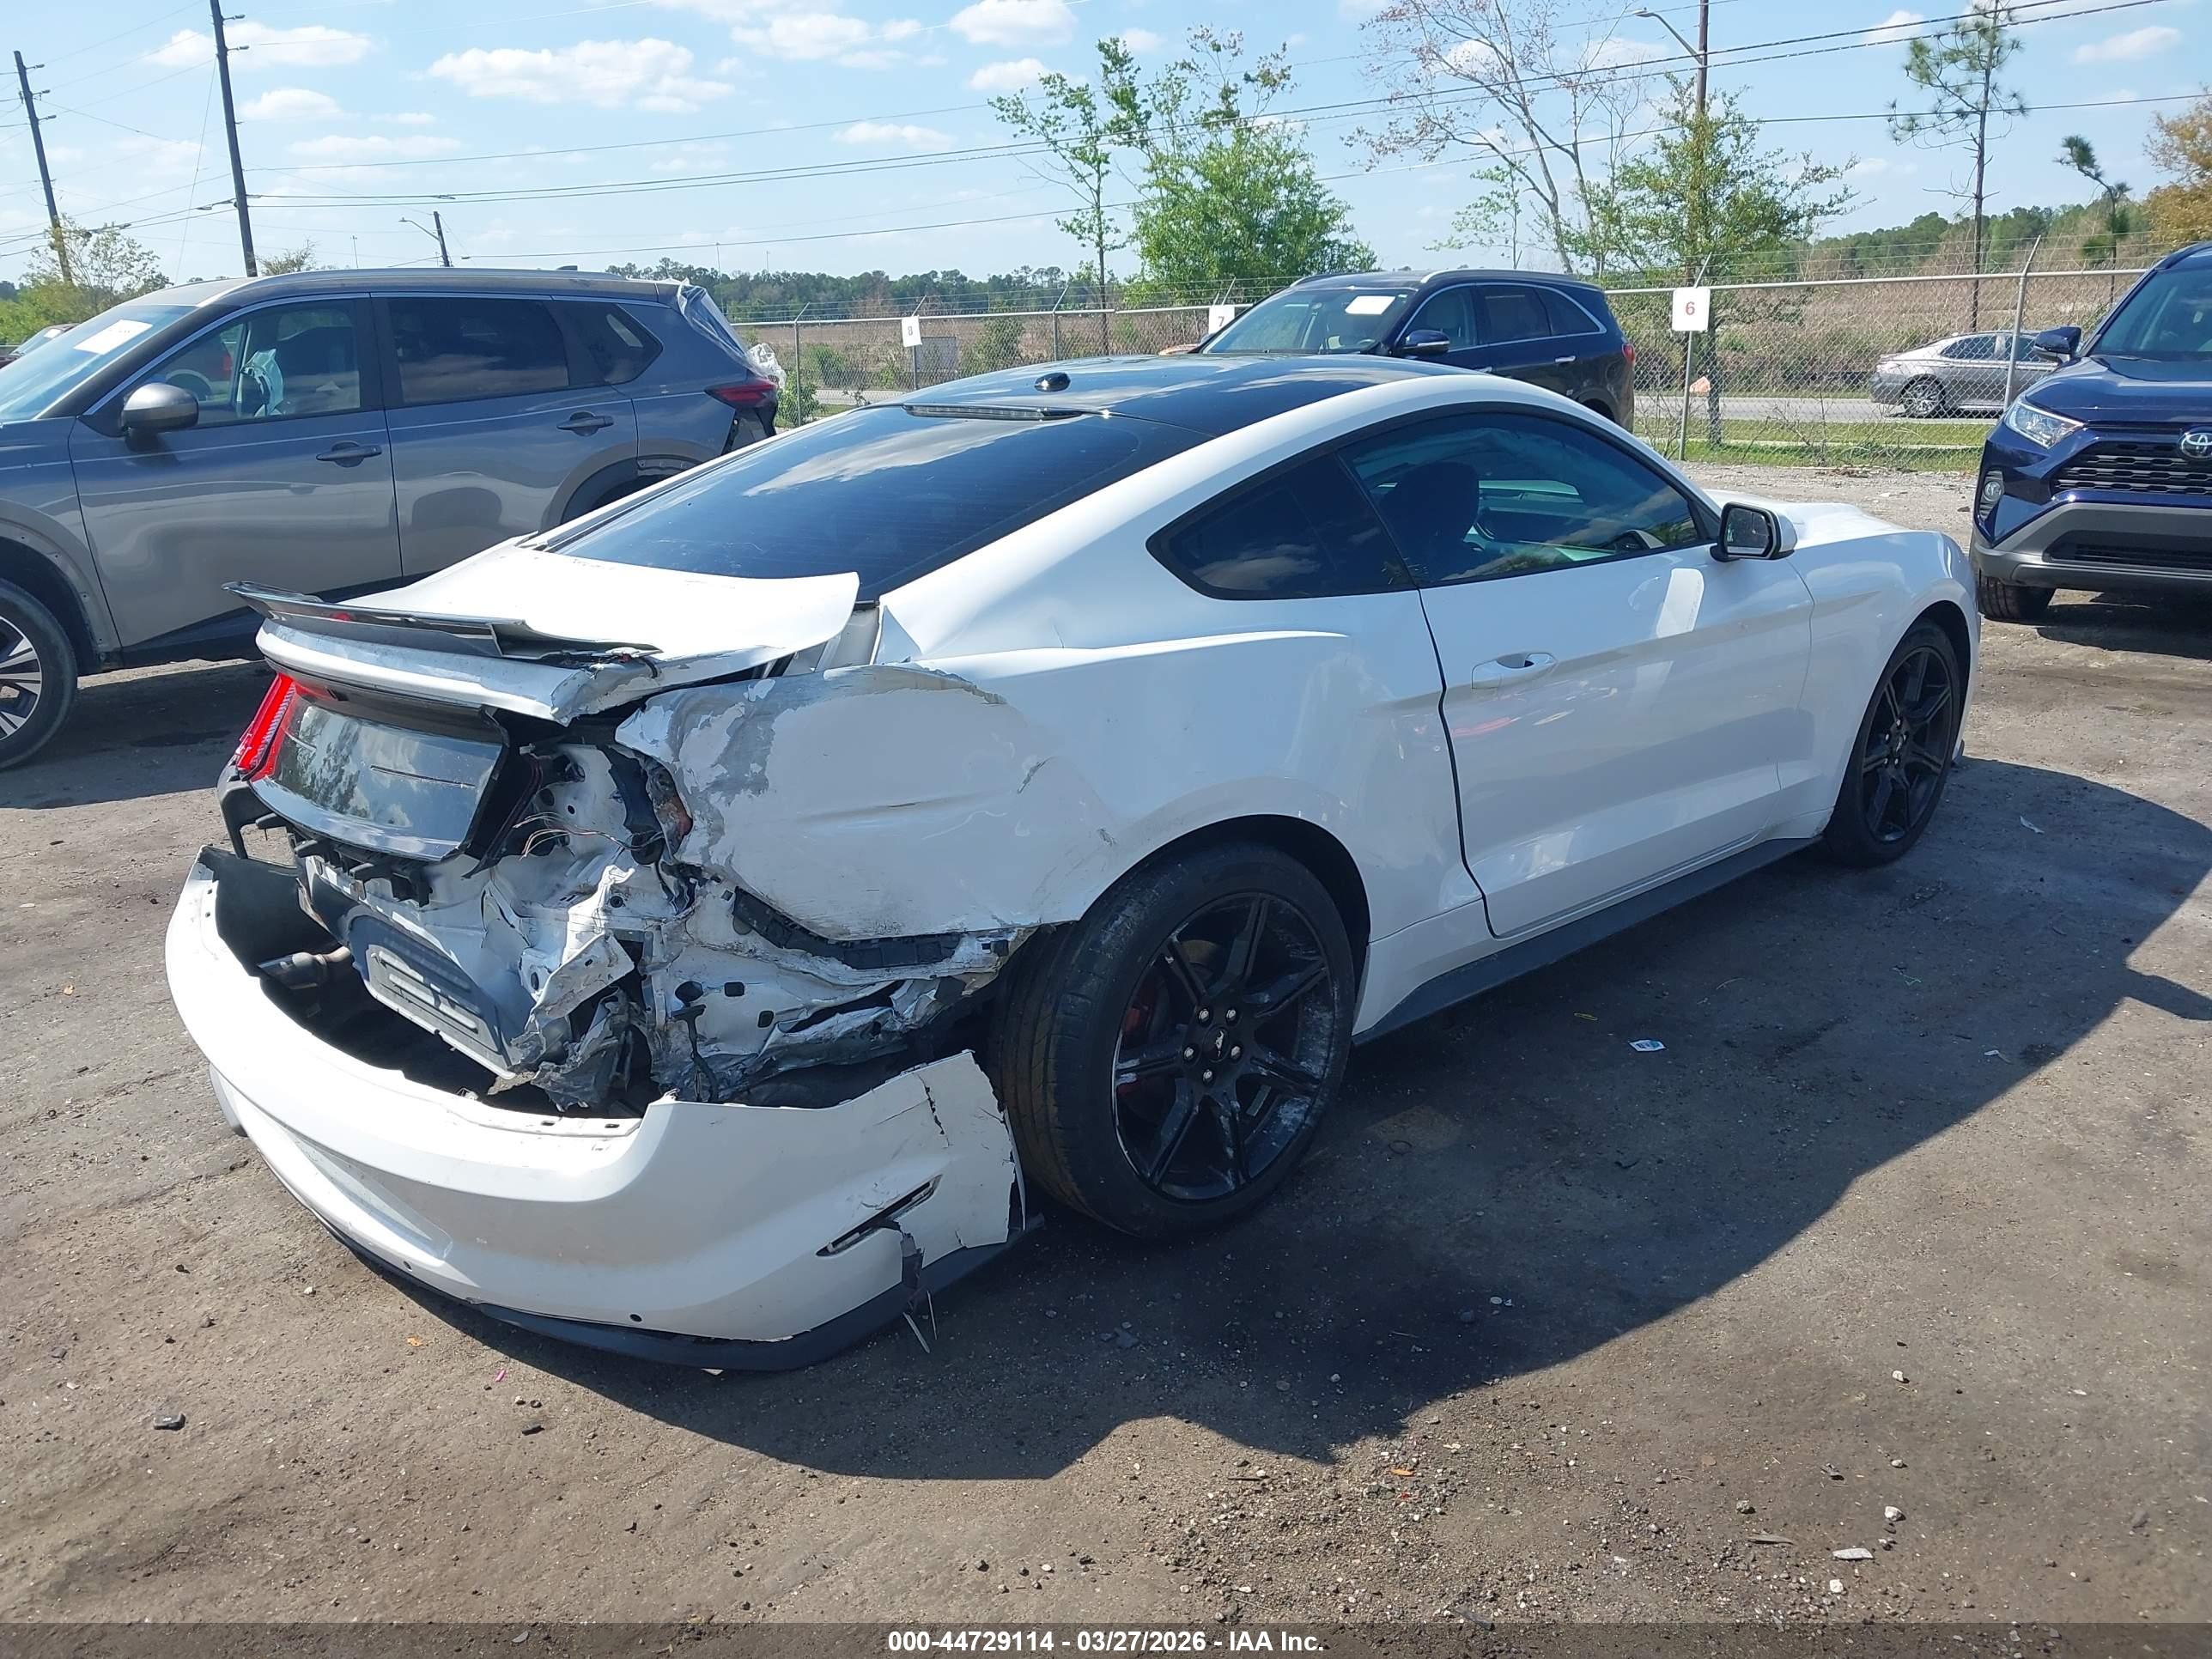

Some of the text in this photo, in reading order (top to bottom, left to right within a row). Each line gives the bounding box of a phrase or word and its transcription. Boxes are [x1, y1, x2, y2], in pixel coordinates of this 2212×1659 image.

[1685, 301, 1695, 315] 6
[1218, 315, 1224, 327] 7
[907, 325, 914, 336] 8
